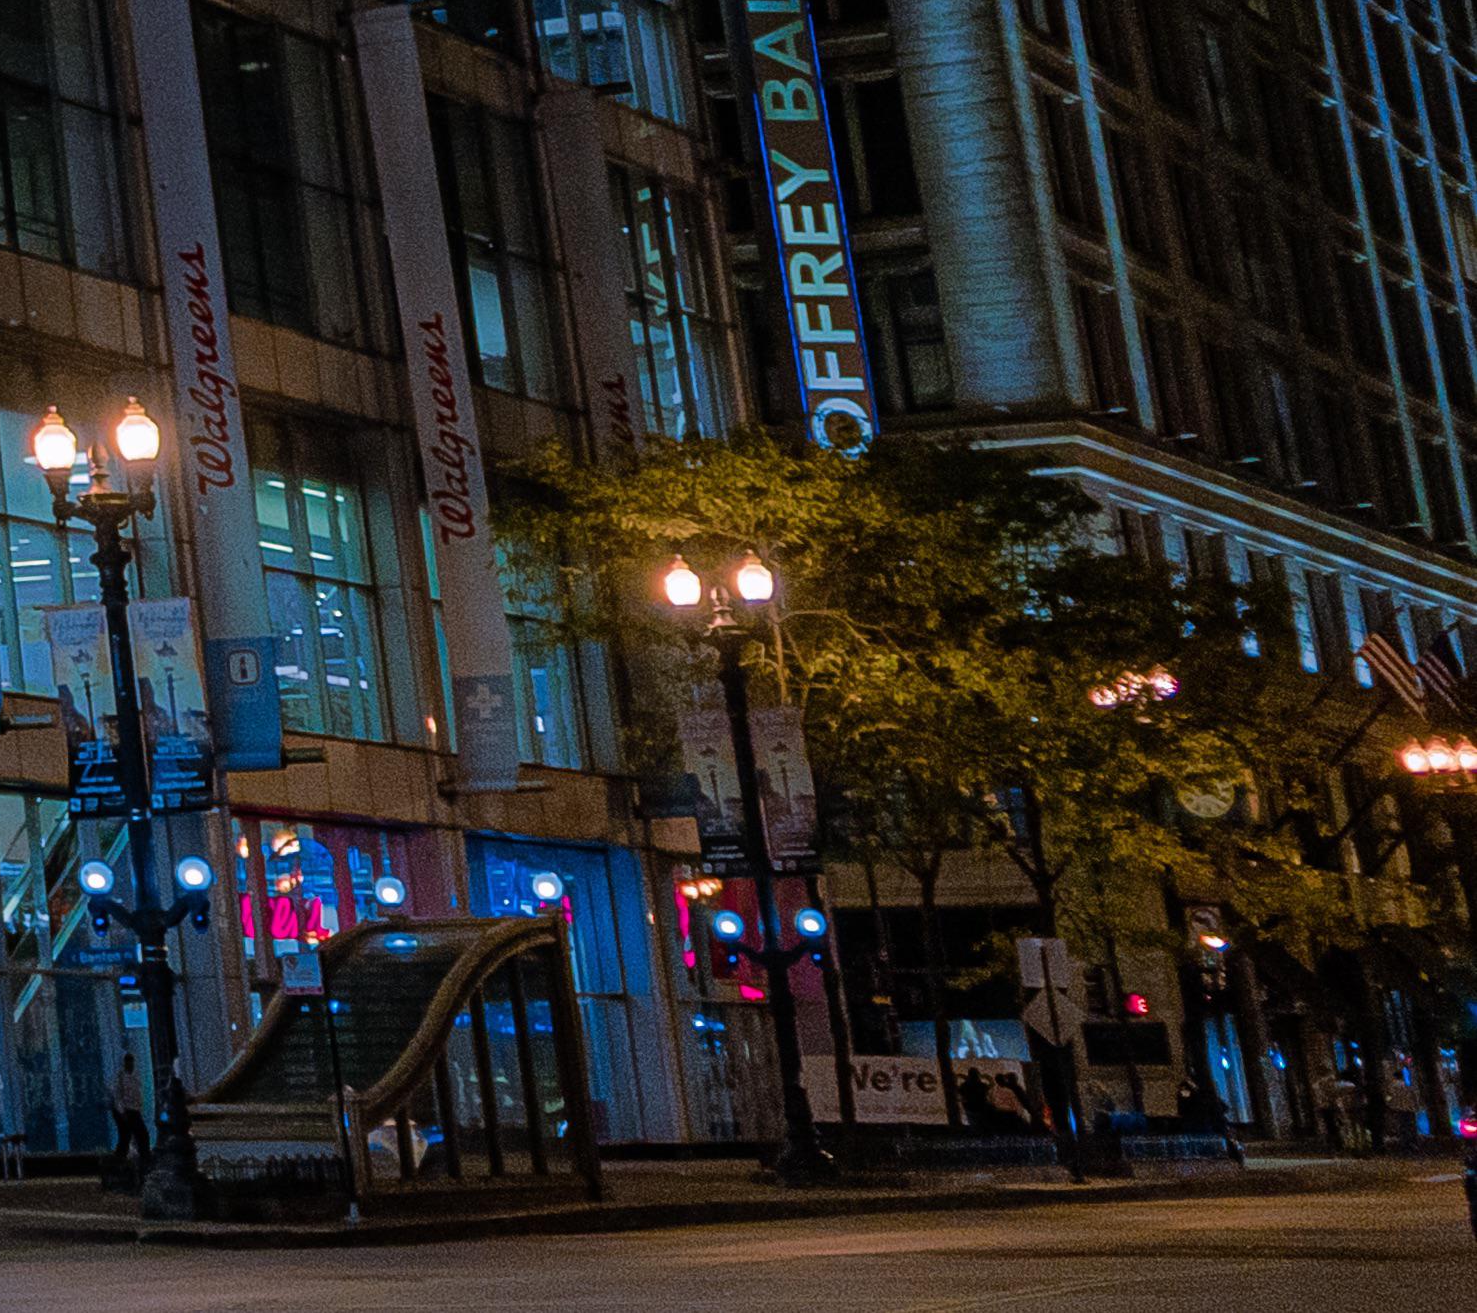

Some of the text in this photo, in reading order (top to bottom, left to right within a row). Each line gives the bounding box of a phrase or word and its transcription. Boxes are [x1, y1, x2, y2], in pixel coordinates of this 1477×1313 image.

[177, 241, 237, 496] Walgreens
[419, 311, 476, 545] Walgreens
[771, 148, 875, 461] OFFREY
